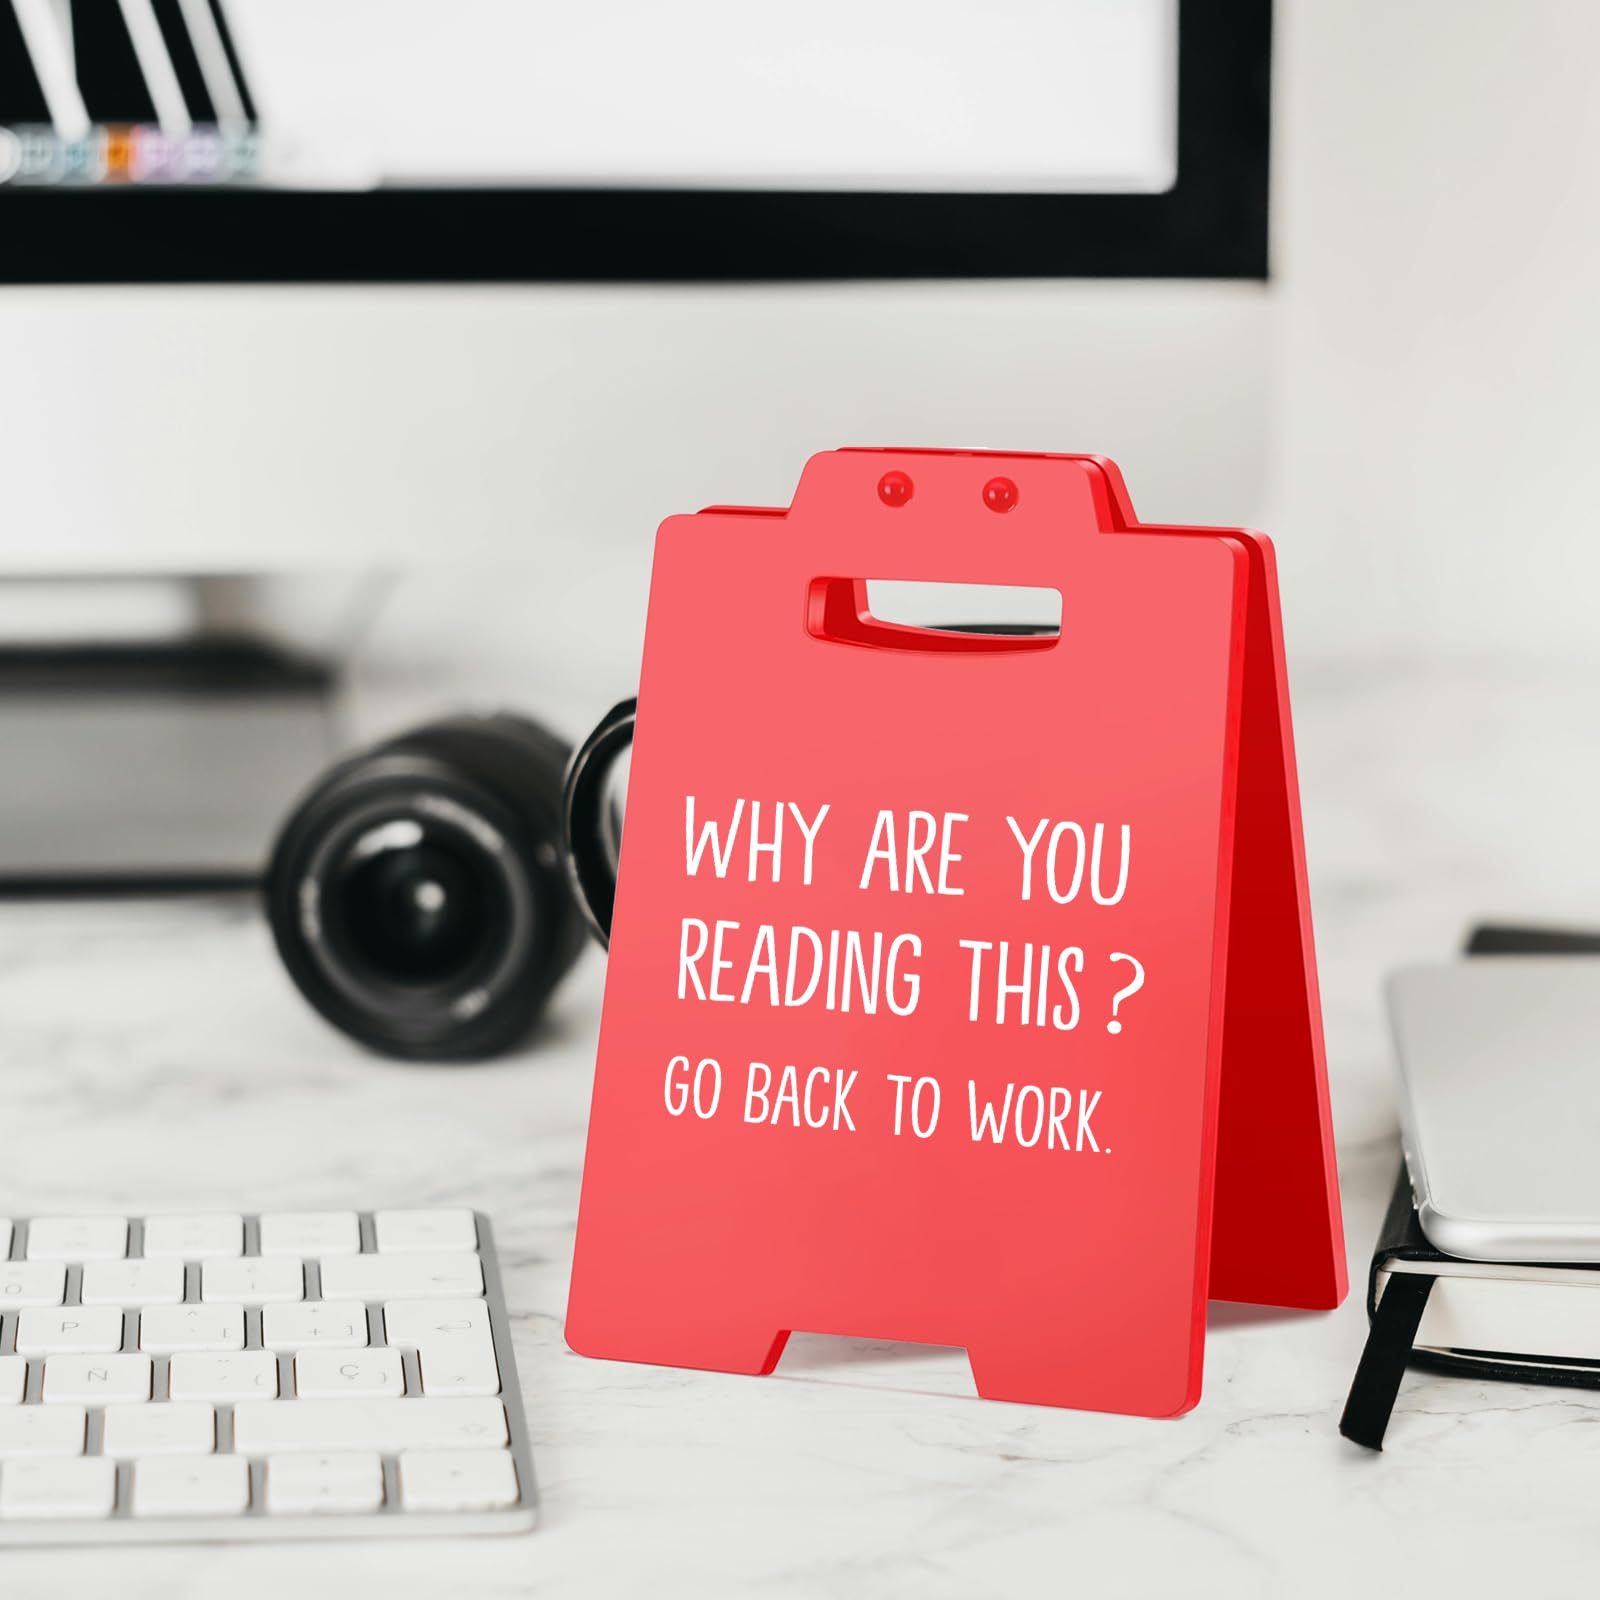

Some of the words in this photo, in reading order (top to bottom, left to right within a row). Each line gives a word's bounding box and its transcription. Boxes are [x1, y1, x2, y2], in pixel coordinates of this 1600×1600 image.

[686, 796, 830, 885] WHY
[859, 810, 969, 896] ARE
[1006, 816, 1130, 906] YOU
[678, 918, 921, 1016] READING
[665, 1056, 721, 1120] GO
[744, 1063, 858, 1131] BACK
[887, 1075, 940, 1139] TO
[969, 1080, 1112, 1154] WORK.
[61, 1321, 79, 1333] P
